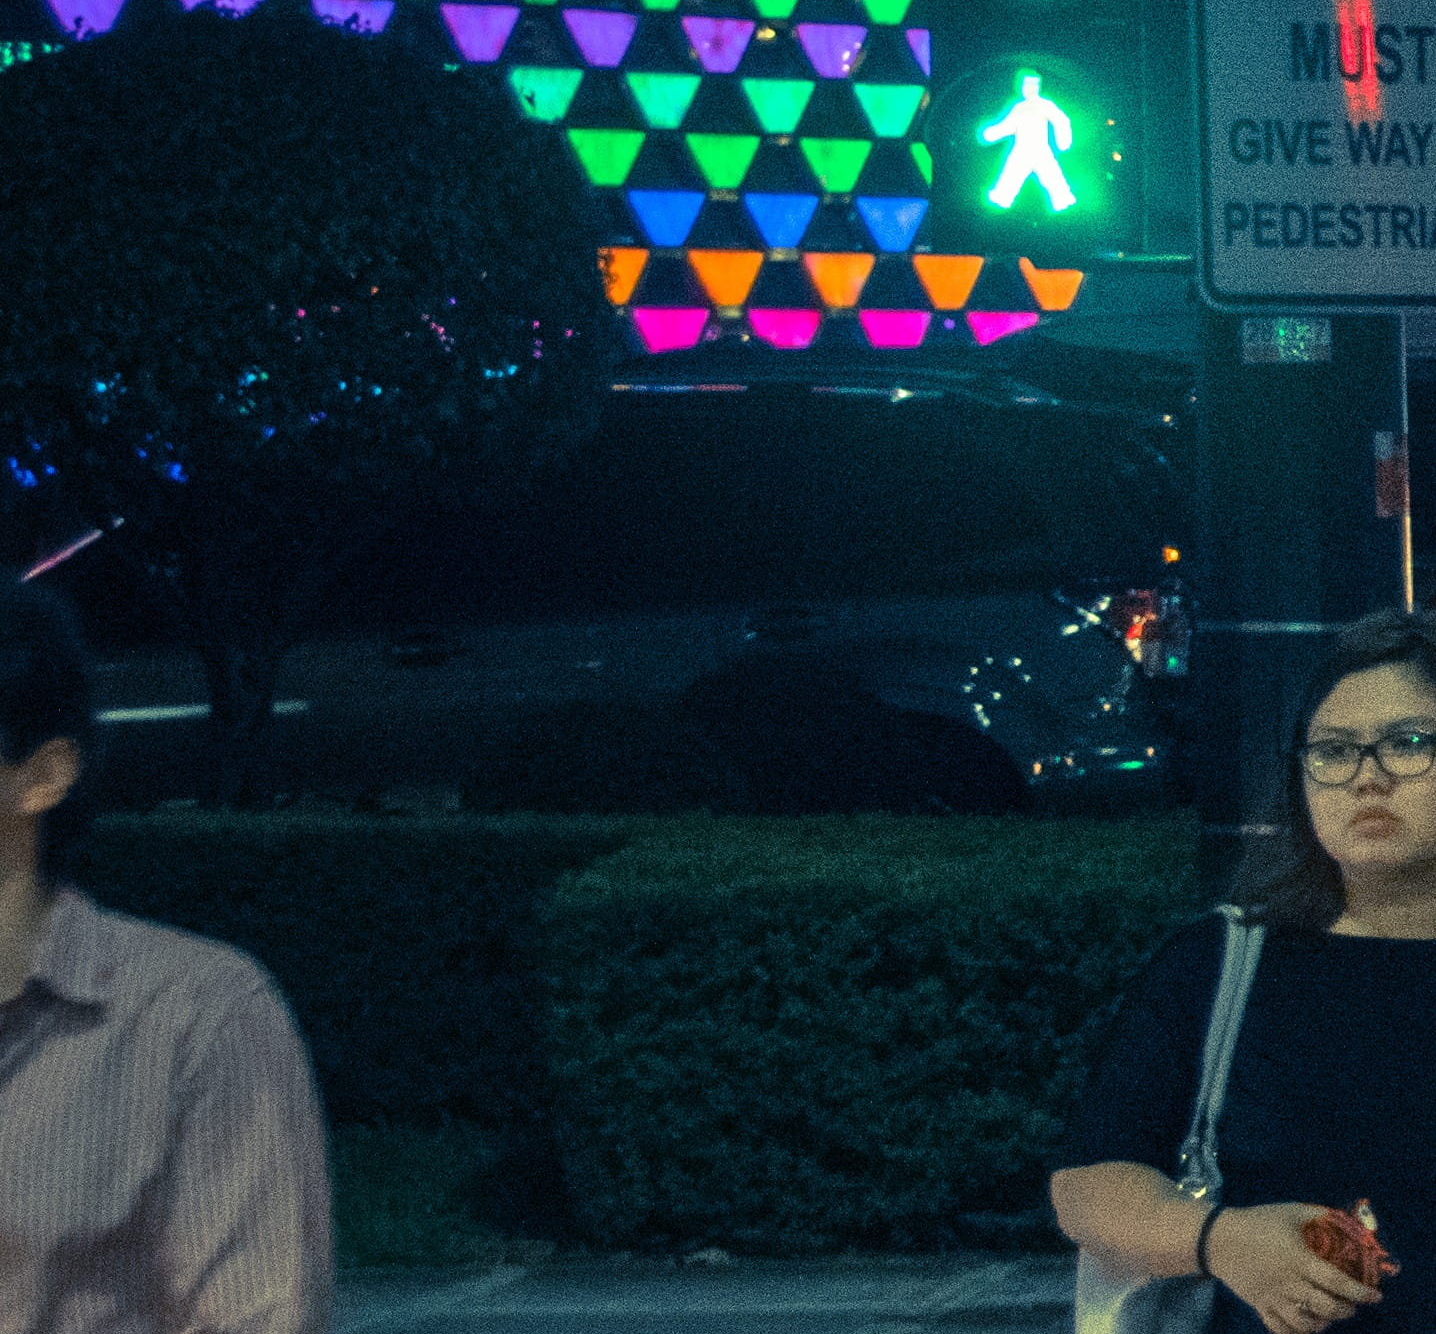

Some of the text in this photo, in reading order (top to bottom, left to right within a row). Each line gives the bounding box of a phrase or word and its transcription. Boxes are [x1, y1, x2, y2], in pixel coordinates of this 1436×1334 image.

[1291, 22, 1436, 84] MUST
[1229, 118, 1333, 167] GIVE
[1345, 120, 1434, 168] WAY
